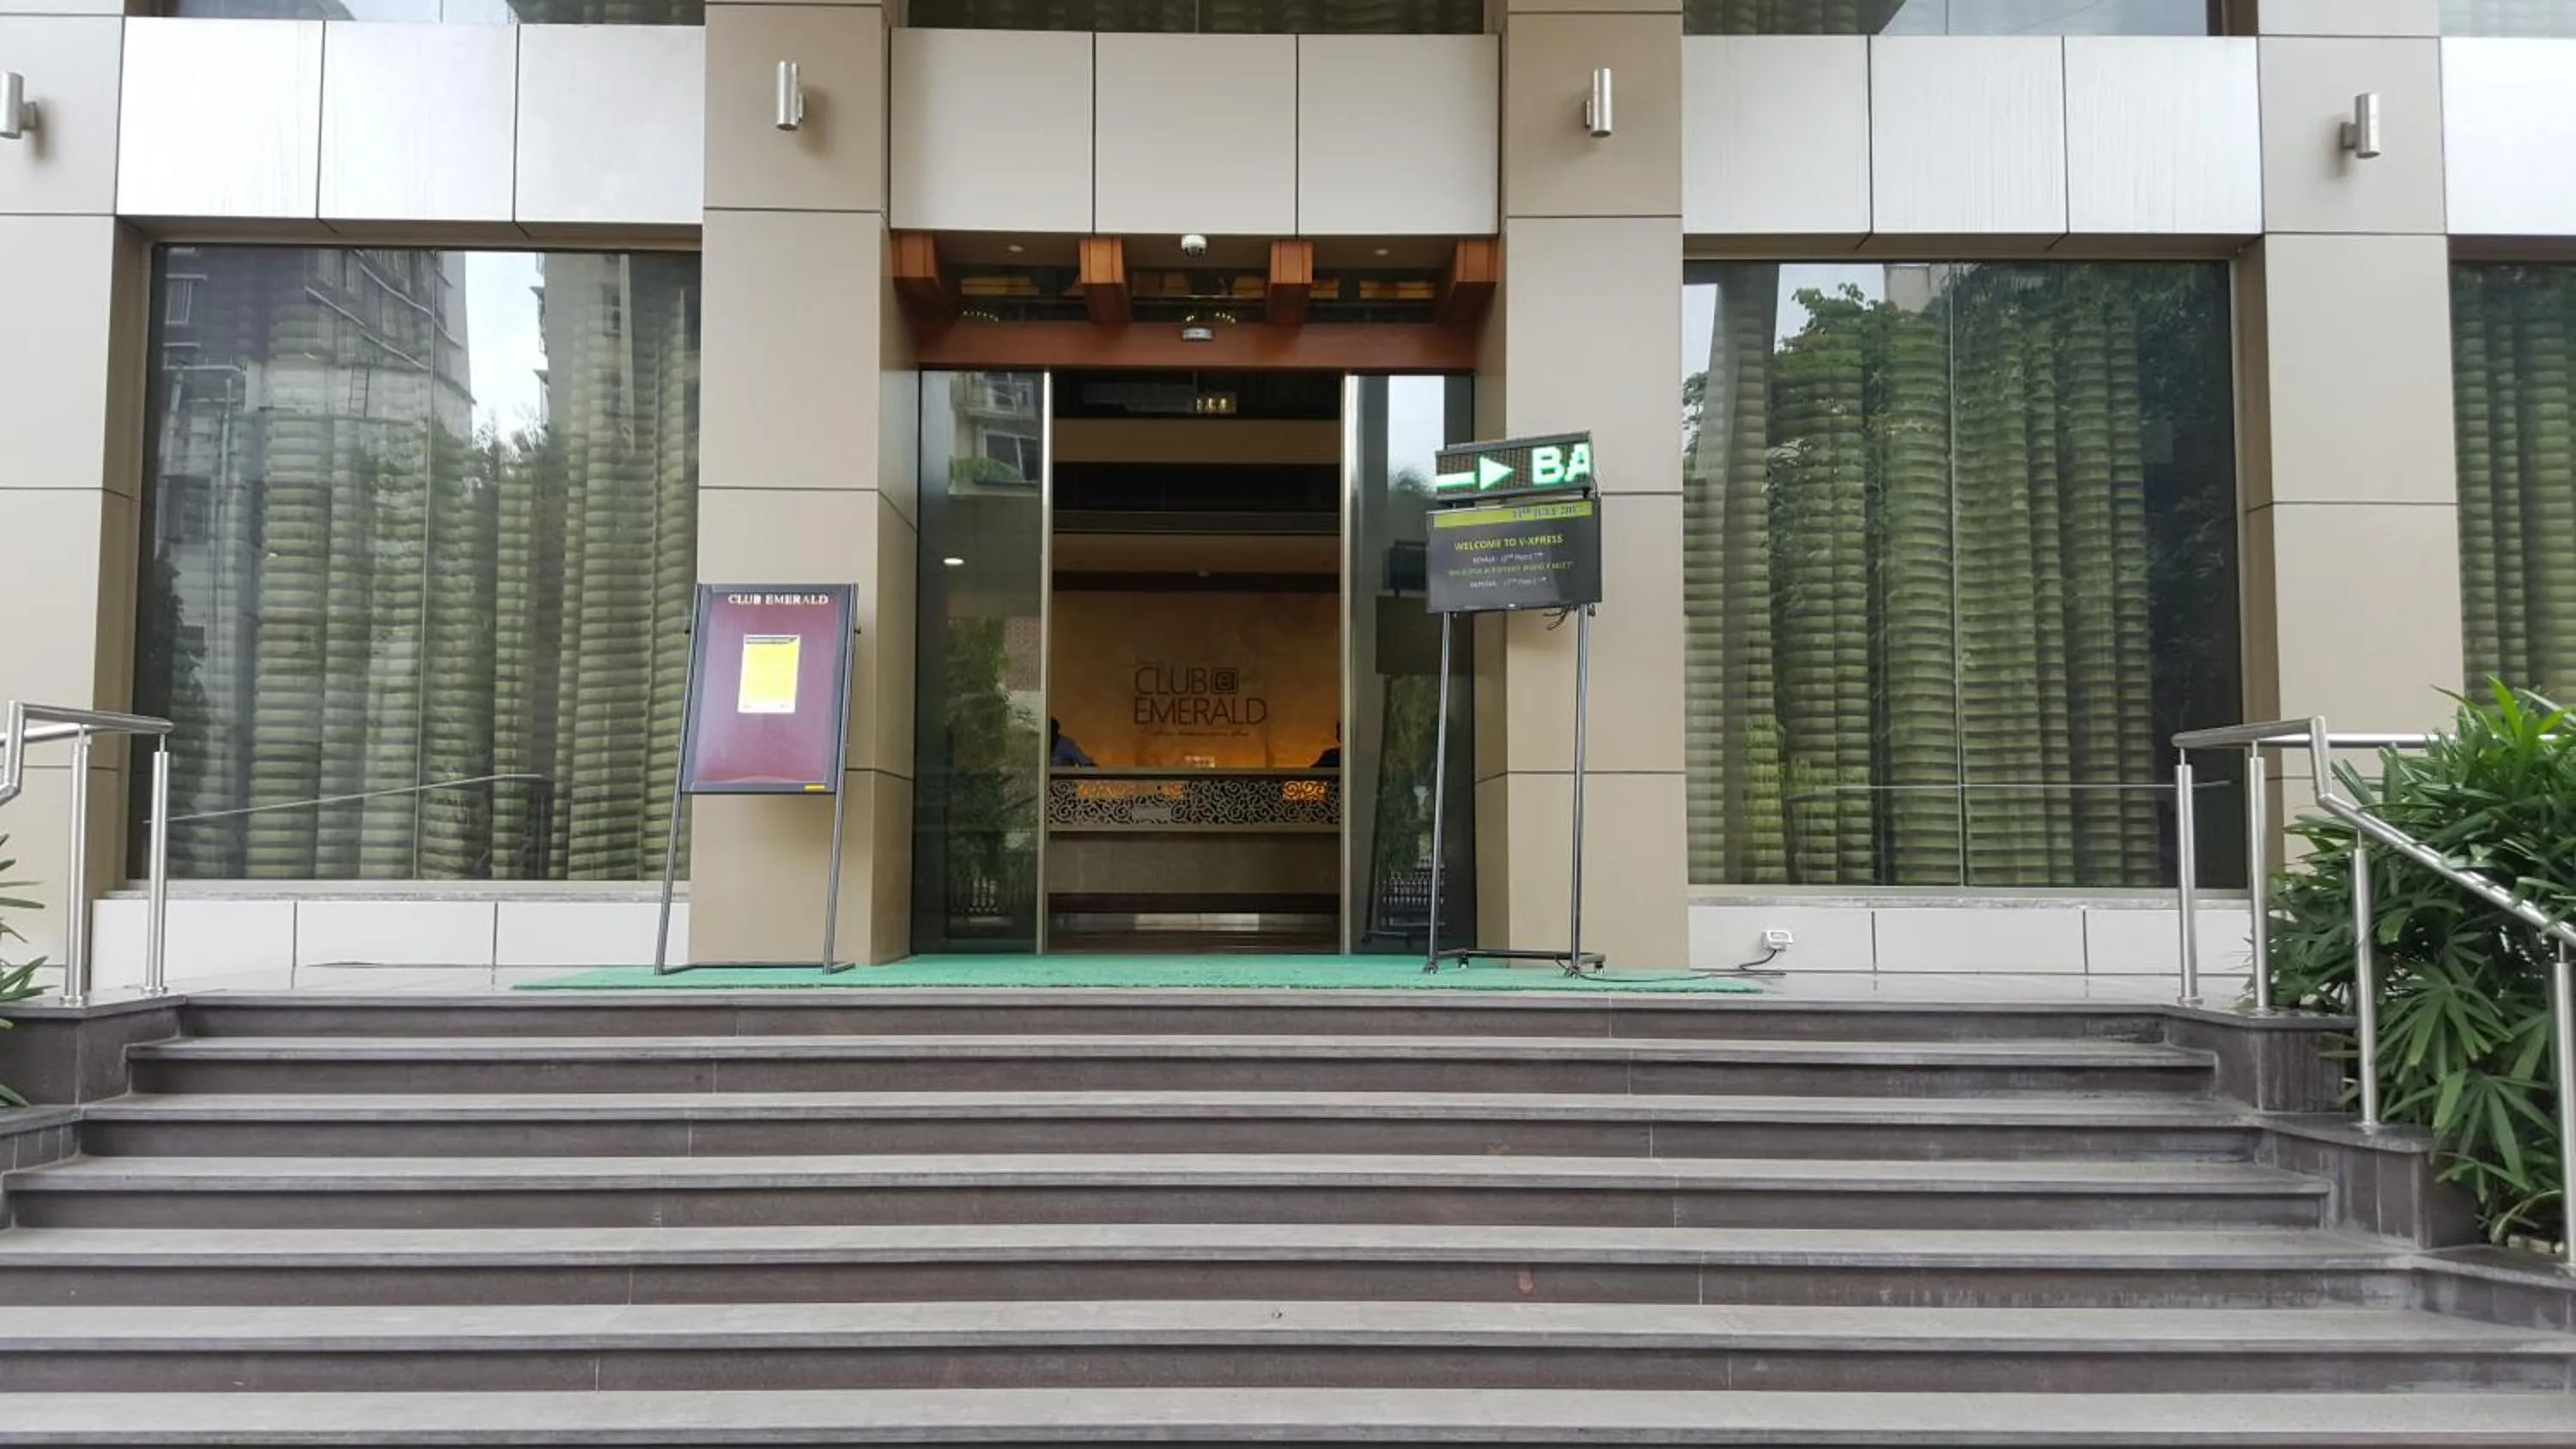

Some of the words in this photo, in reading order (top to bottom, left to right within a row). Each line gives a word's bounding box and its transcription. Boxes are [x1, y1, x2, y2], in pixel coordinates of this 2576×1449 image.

[1532, 441, 1589, 485] BA
[1454, 538, 1502, 550] WELCOME
[1504, 537, 1517, 547] TO
[727, 593, 762, 605] CLUB
[765, 593, 829, 605] EMERALD
[1133, 665, 1207, 695] CLUB
[1133, 696, 1268, 726] EMERALD
